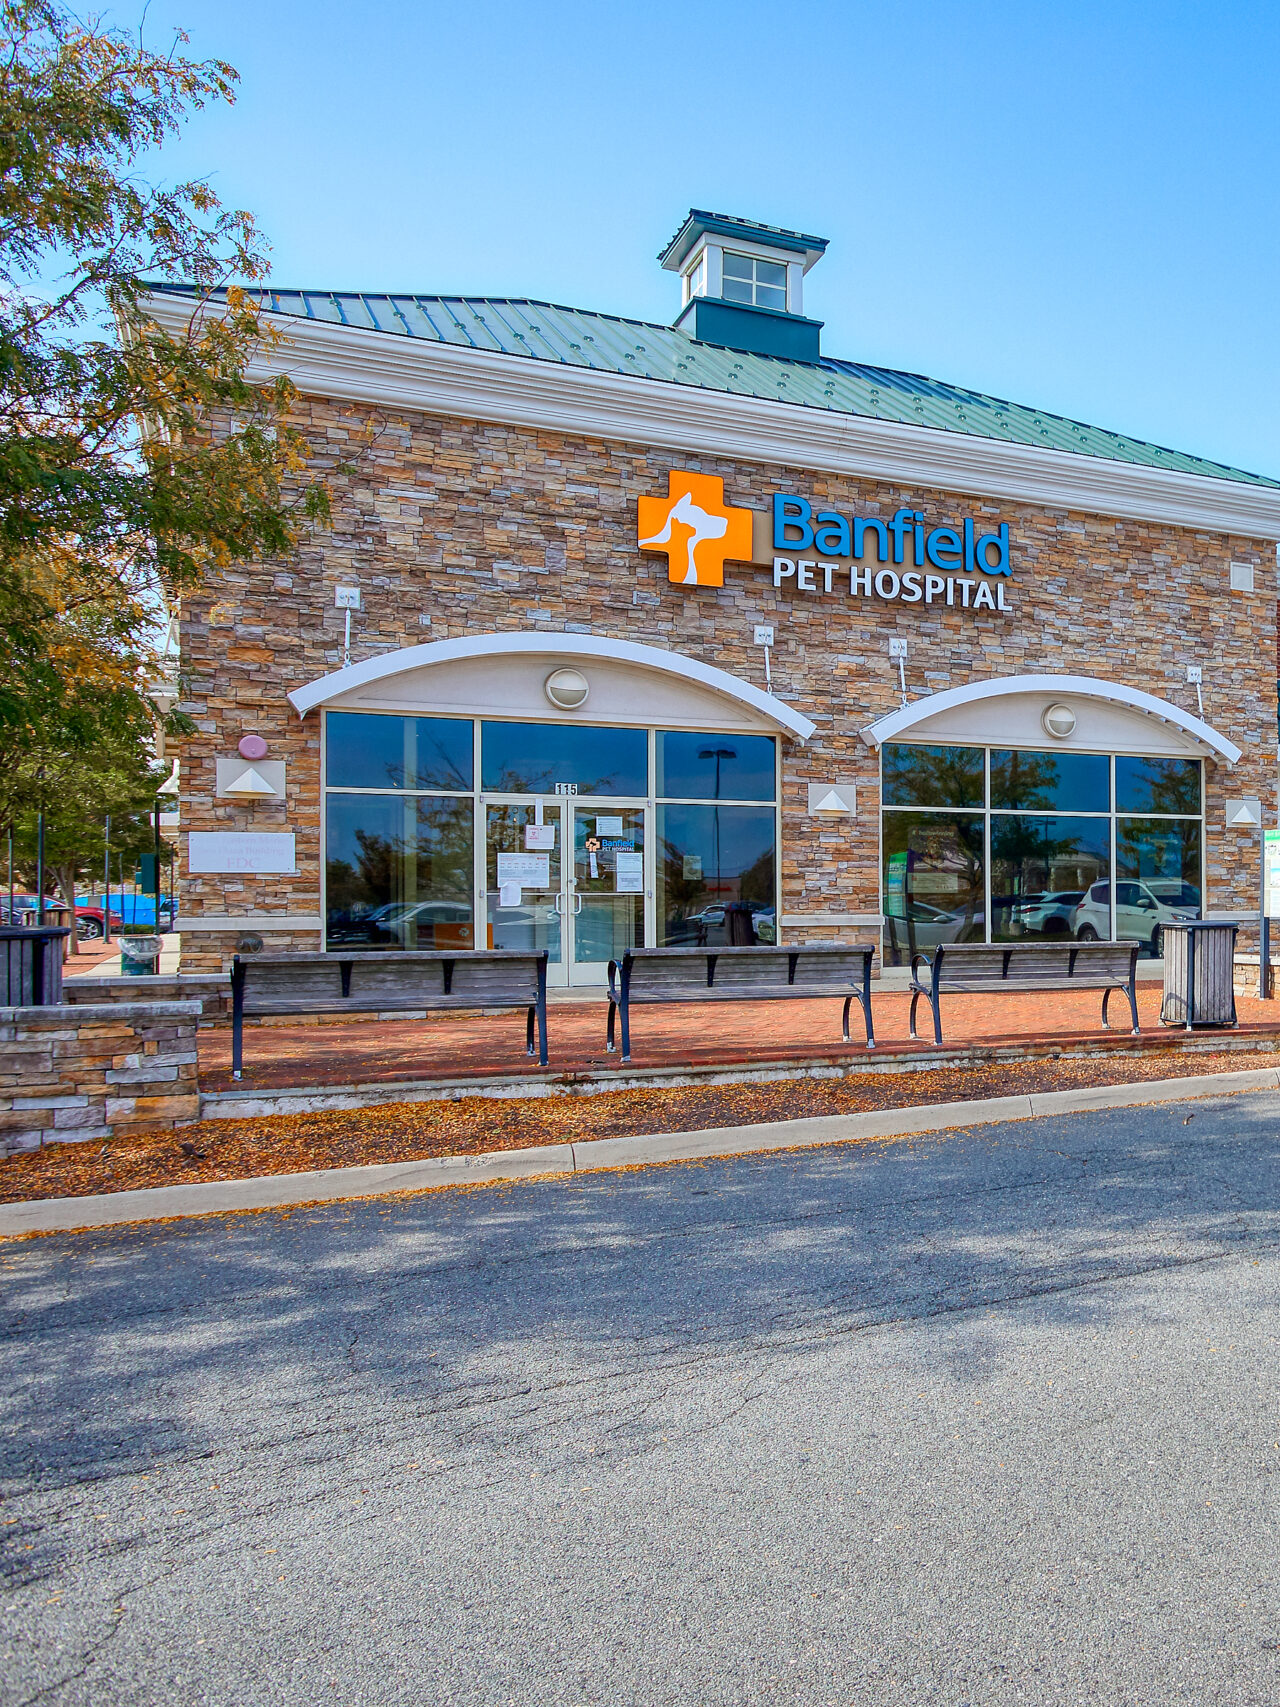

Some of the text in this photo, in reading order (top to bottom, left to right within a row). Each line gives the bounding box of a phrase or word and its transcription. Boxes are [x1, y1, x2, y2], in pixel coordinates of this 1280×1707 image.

[773, 493, 1013, 578] Banfield
[773, 557, 1014, 612] PET HOSPITAL
[556, 783, 577, 795] 115
[602, 839, 635, 847] Banfield
